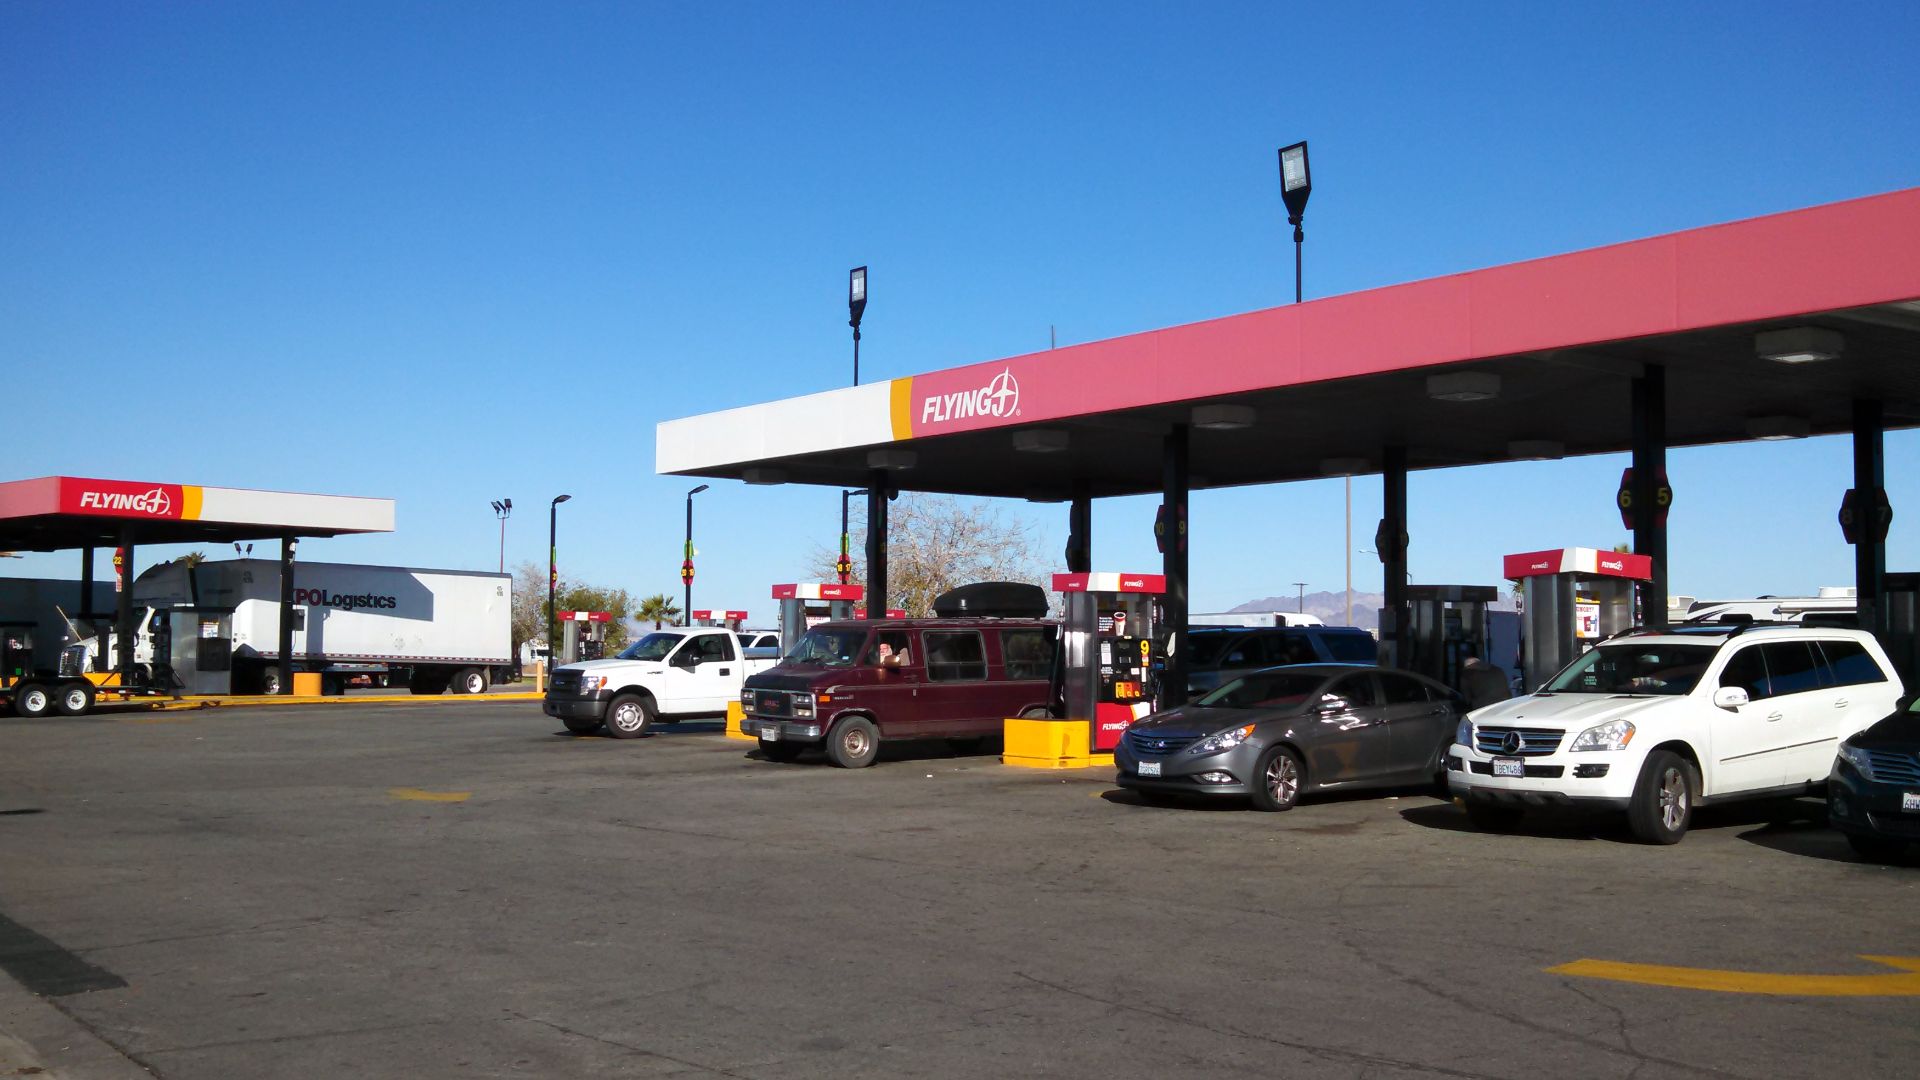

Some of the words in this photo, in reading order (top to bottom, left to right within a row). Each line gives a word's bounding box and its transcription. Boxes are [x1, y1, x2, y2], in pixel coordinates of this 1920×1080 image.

[1620, 490, 1632, 508] 6
[1657, 487, 1669, 505] 5
[1140, 639, 1150, 655] 9
